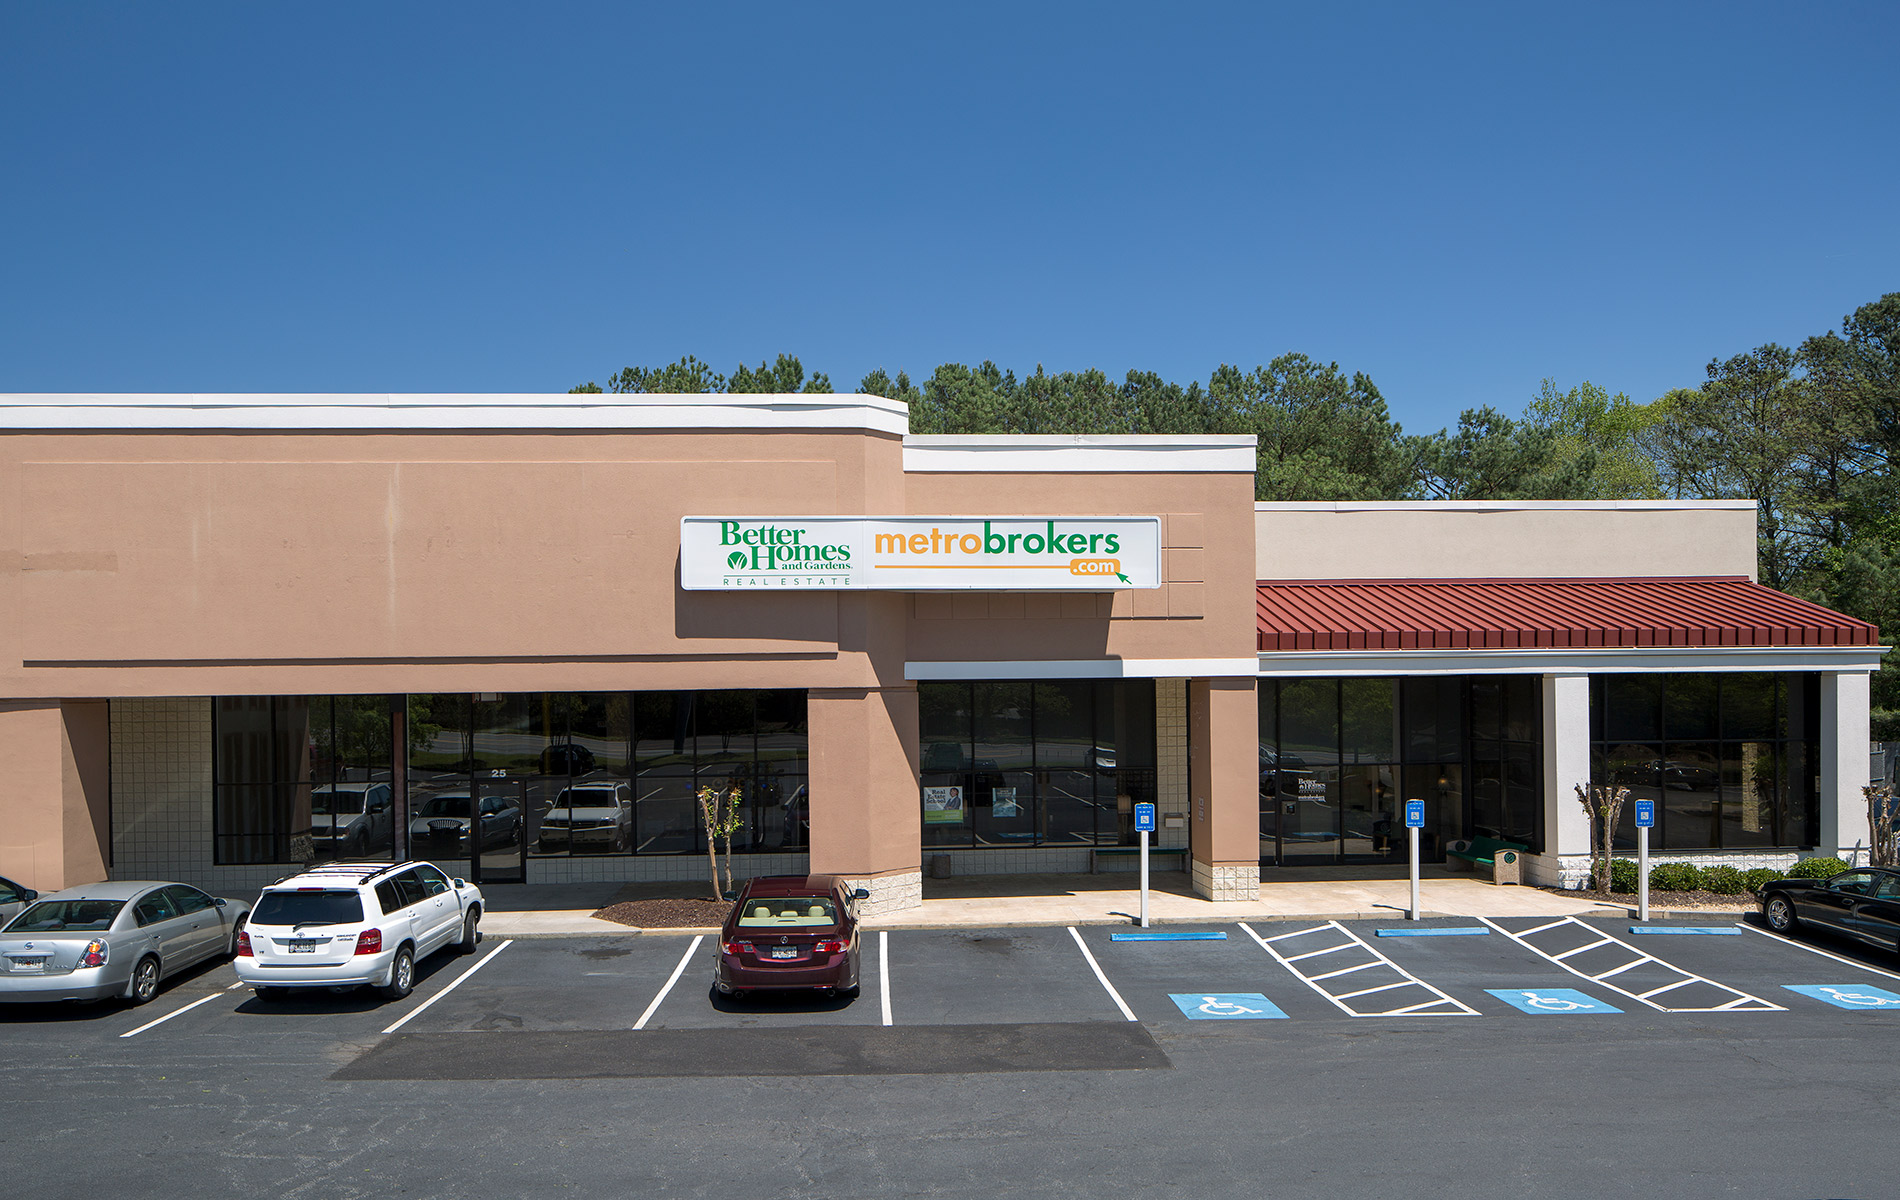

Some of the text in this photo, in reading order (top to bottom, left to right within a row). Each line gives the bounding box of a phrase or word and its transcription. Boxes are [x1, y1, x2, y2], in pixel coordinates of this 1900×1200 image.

[719, 521, 806, 546] Better
[875, 521, 1121, 554] metrobrokers
[749, 545, 851, 570] Homes
[781, 561, 803, 570] and
[1072, 561, 1115, 573] .com
[723, 577, 850, 586] REAL ESTATE
[491, 769, 507, 778] 25
